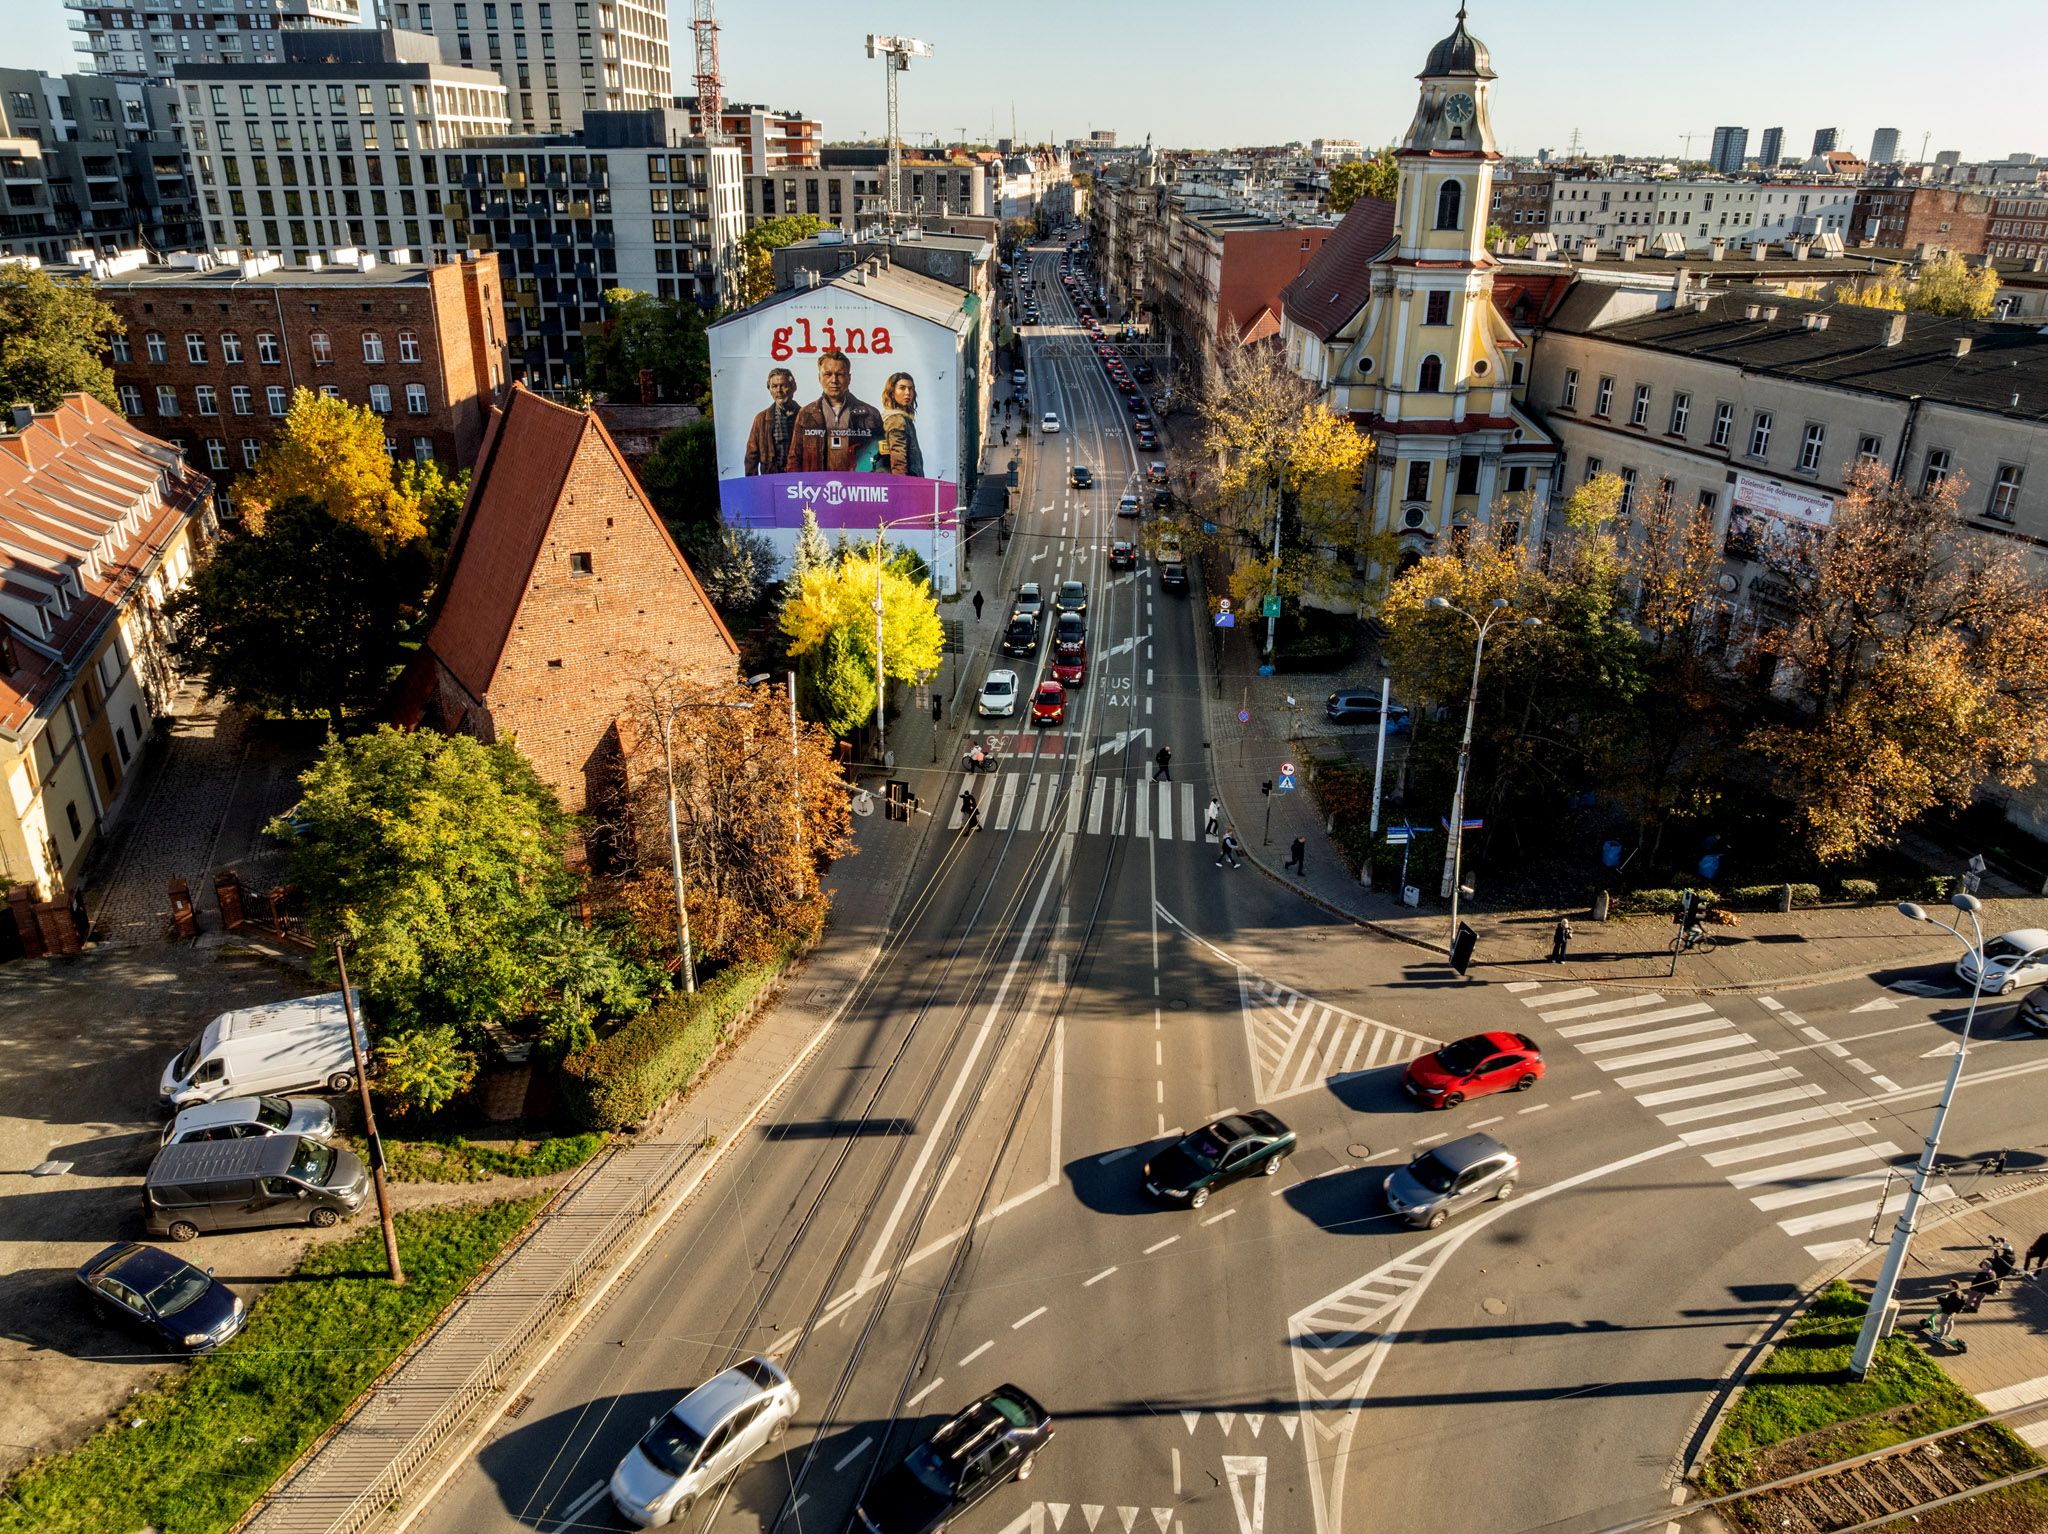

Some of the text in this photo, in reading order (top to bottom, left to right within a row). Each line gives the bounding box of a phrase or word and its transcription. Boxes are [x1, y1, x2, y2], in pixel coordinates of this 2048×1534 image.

[770, 317, 893, 361] glina
[804, 429, 826, 437] nowy
[1740, 477, 1766, 490] Dzielenie
[1766, 485, 1775, 494] się
[1775, 486, 1797, 499] dobrem
[1797, 494, 1829, 509] procentuje
[1100, 694, 1137, 707] AXI
